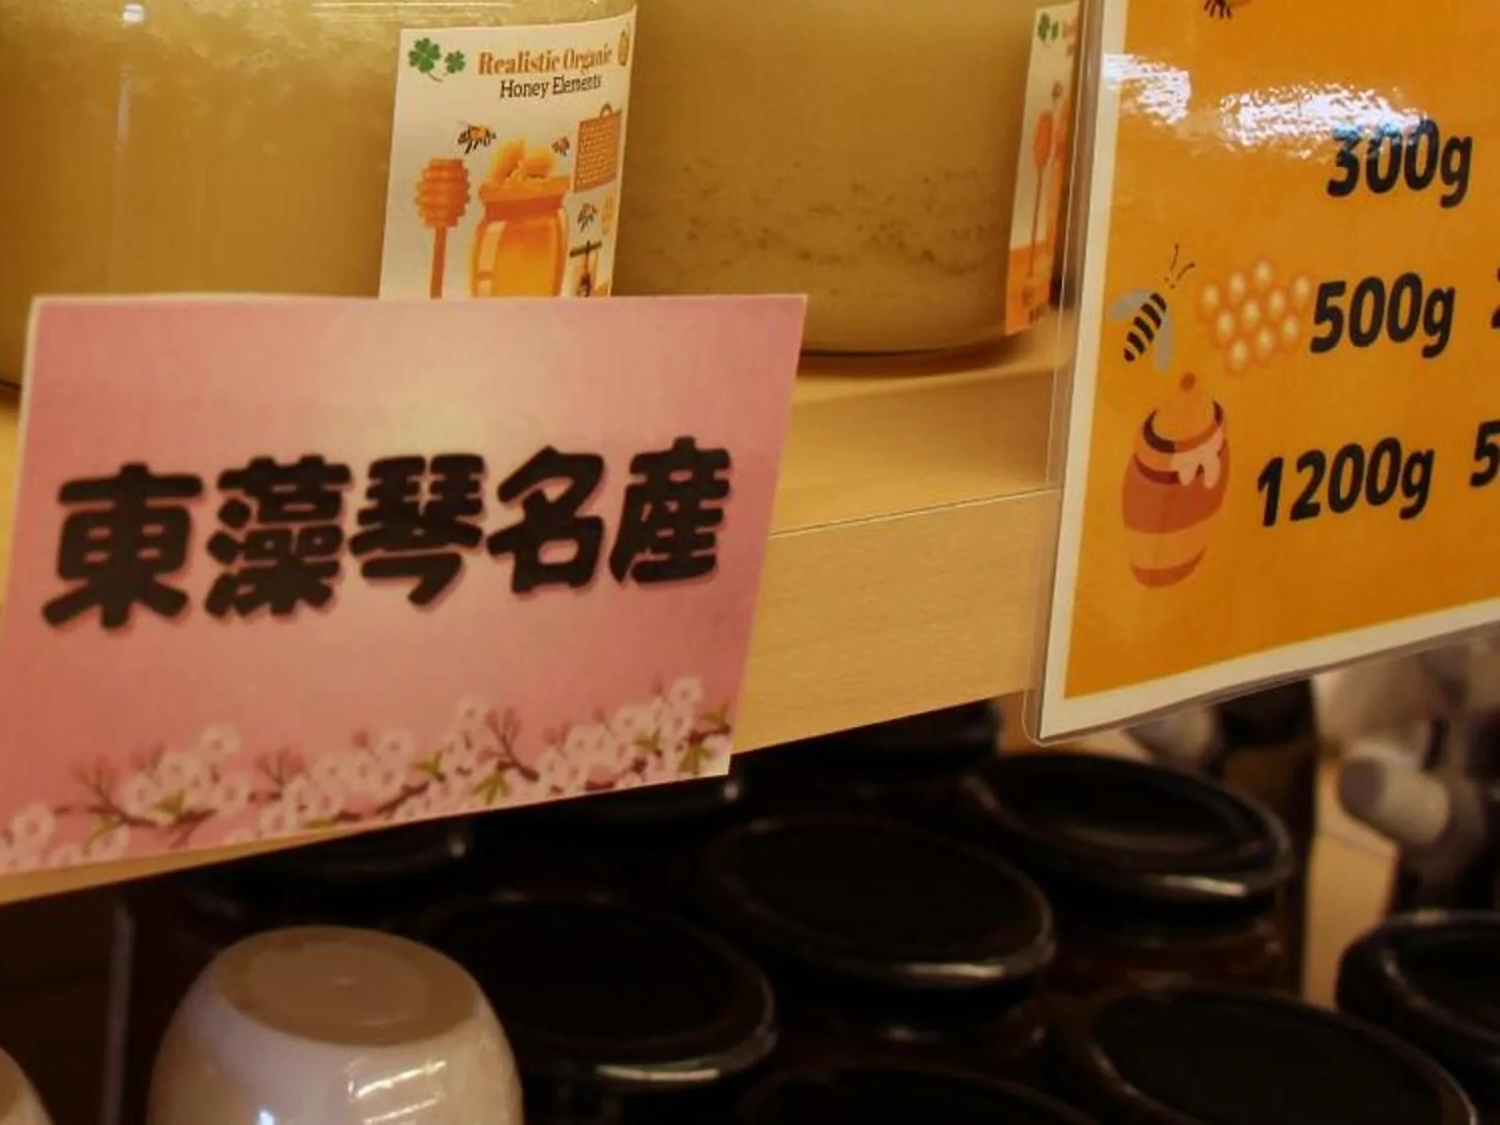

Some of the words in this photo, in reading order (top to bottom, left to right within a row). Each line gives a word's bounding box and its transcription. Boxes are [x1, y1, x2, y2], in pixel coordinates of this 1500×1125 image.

[478, 49, 561, 75] Realistic
[563, 42, 613, 74] Organic
[500, 77, 550, 99] Honey
[552, 74, 602, 96] Elements
[1327, 117, 1473, 208] 300g
[1310, 271, 1456, 359] 500g
[1257, 436, 1435, 527] 1200g
[41, 434, 733, 631] 東藻琴名産
